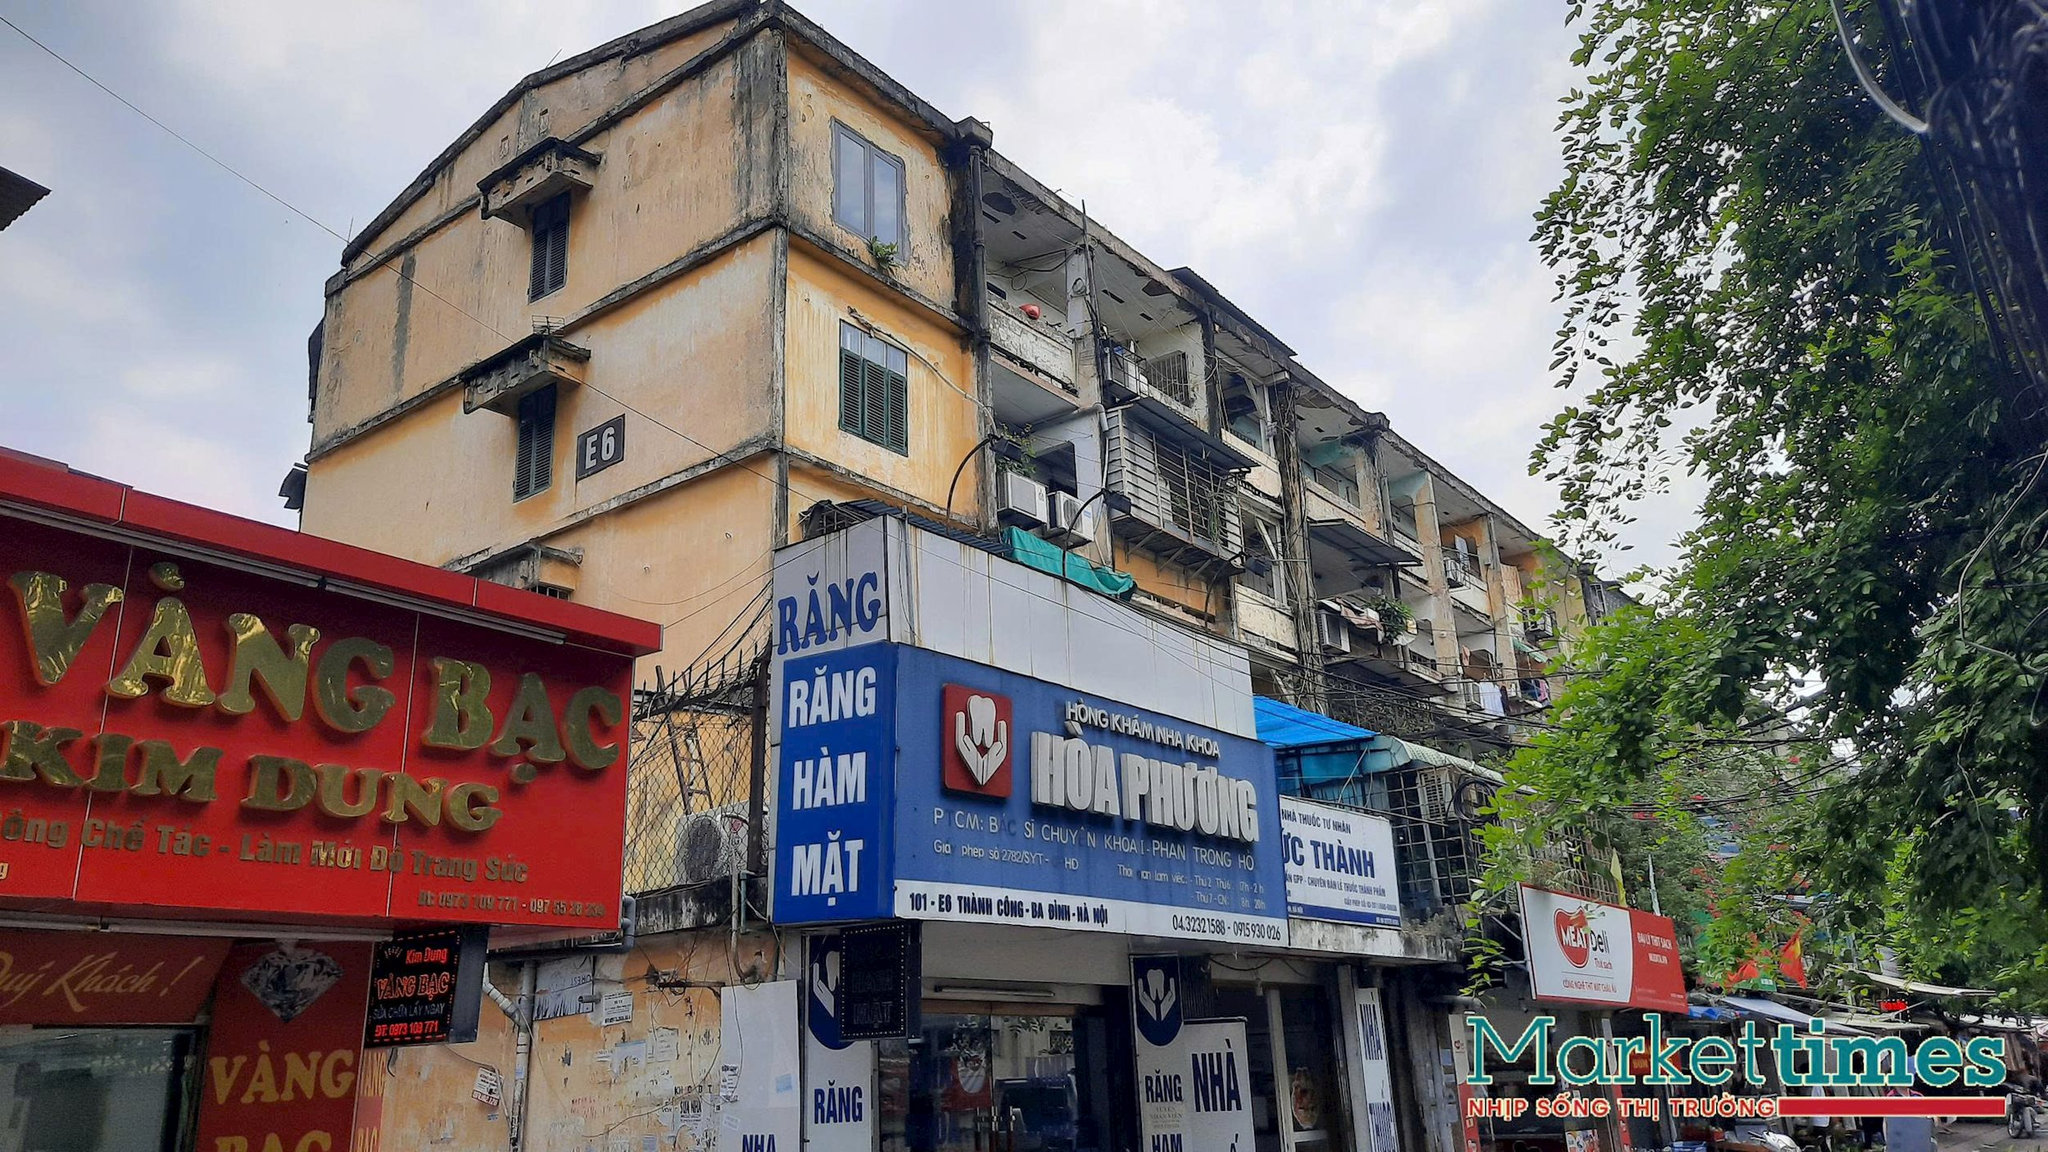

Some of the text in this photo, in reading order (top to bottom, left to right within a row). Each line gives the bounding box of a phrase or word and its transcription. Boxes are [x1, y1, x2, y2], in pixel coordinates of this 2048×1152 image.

[586, 427, 615, 470] E6
[777, 571, 881, 655] RĂNG
[7, 562, 624, 785] VÀNG BẠC
[788, 665, 877, 728] RĂNG
[1109, 714, 1155, 741] KHÁM
[1155, 726, 1184, 749] NHA
[1185, 733, 1221, 758] KHOA
[0, 720, 503, 832] KIM DUNG
[792, 747, 867, 810] HÀM
[1031, 721, 1259, 843] HÒA PHƯƠNG
[81, 815, 148, 851] Chế
[156, 823, 212, 857] Tác
[239, 832, 300, 866] Làm
[309, 840, 362, 871] Mới
[411, 849, 478, 882] Trang
[484, 853, 529, 884] Sức
[791, 830, 864, 906] MẶT
[1104, 834, 1138, 853] KHOA
[1152, 840, 1186, 861] PHAN
[1193, 846, 1232, 870] TRỌNG
[1310, 839, 1375, 879] THÀNH
[909, 892, 928, 911] 101
[938, 894, 952, 912] E6
[957, 892, 993, 915] THÀNH
[997, 895, 1025, 917] CÔNG
[1031, 902, 1044, 918] BA
[1048, 899, 1071, 921] ĐÌNH
[1077, 902, 1090, 923] HÀ
[1093, 904, 1109, 927] NỘI
[42, 951, 166, 1013] Khách
[406, 949, 422, 965] Kim
[424, 946, 449, 964] Dung
[209, 1040, 355, 1104] VÀNG
[814, 1080, 863, 1124] RĂNG
[1145, 1069, 1182, 1103] RĂNG
[1192, 1038, 1242, 1112] NHÀ
